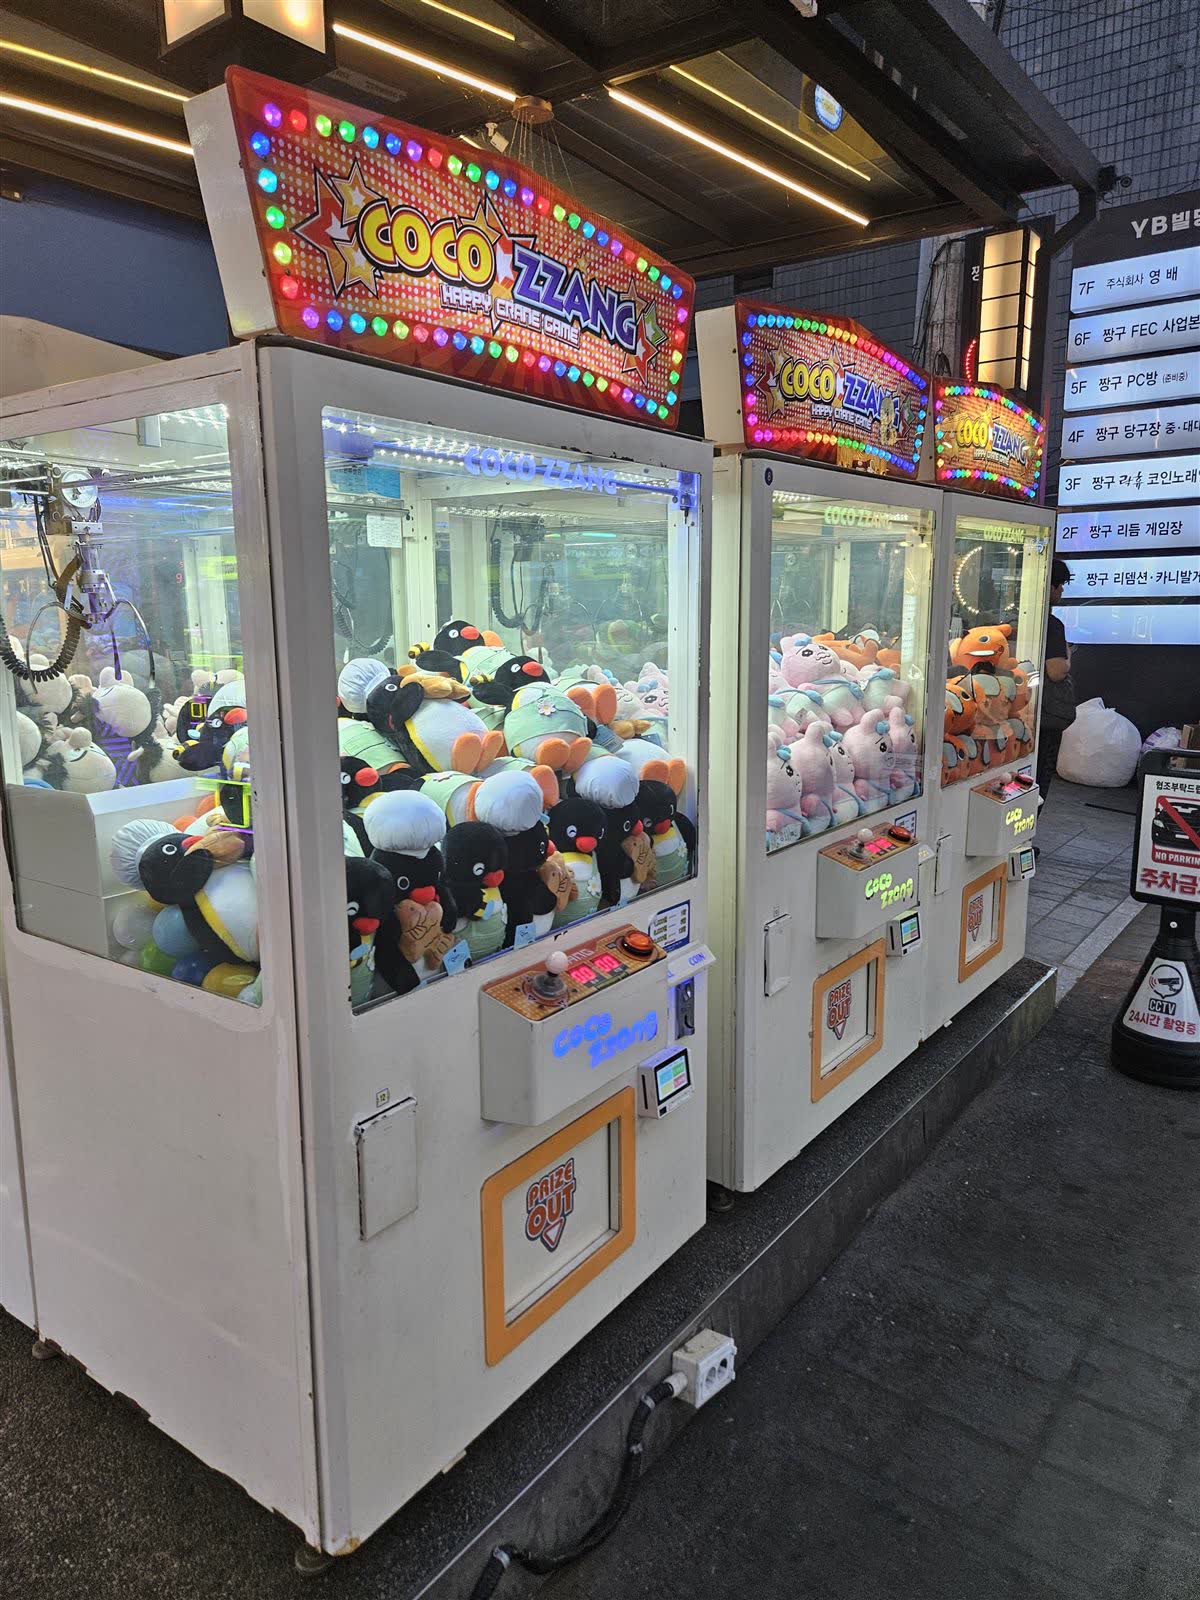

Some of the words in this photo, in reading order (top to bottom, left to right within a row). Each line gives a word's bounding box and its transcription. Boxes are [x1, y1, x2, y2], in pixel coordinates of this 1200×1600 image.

[358, 202, 496, 287] COCO
[512, 243, 638, 350] ZZANG
[1078, 281, 1095, 296] 7F
[1106, 273, 1144, 290] 주식회사
[440, 283, 493, 316] HAPPY
[495, 298, 541, 332] CRANE
[543, 313, 580, 349] GAME
[1074, 331, 1091, 346] 6F
[1103, 326, 1126, 343] 짱구
[1131, 321, 1158, 338] FEC
[780, 358, 836, 403] COCO
[1070, 380, 1088, 395] 5F
[1099, 376, 1122, 392] 짱구
[1127, 371, 1158, 387] PC방
[1162, 371, 1188, 384] (준비중)
[957, 417, 989, 448] COCO
[1067, 429, 1085, 444] 4F
[1096, 426, 1119, 442] 짱구
[1124, 421, 1161, 439] 당구장
[463, 446, 536, 481] COCO
[541, 457, 617, 495] ZZANG
[1065, 477, 1081, 491] 3F
[1092, 474, 1115, 490] 짱구
[1147, 467, 1200, 485] 코인노래
[1062, 526, 1079, 540] 2F
[1089, 524, 1112, 539] 짱구
[1117, 523, 1140, 537] 리듬
[1145, 520, 1183, 536] 게임장
[1086, 571, 1109, 587] 짱구
[1155, 851, 1167, 861] NO
[1141, 867, 1200, 896] 주차금
[688, 951, 705, 967] COIN
[828, 1000, 850, 1028] OUT
[1128, 1010, 1161, 1027] 24시간
[1150, 999, 1175, 1015] CCTV
[527, 1158, 575, 1212] PRIZE
[526, 1180, 576, 1240] OUT
